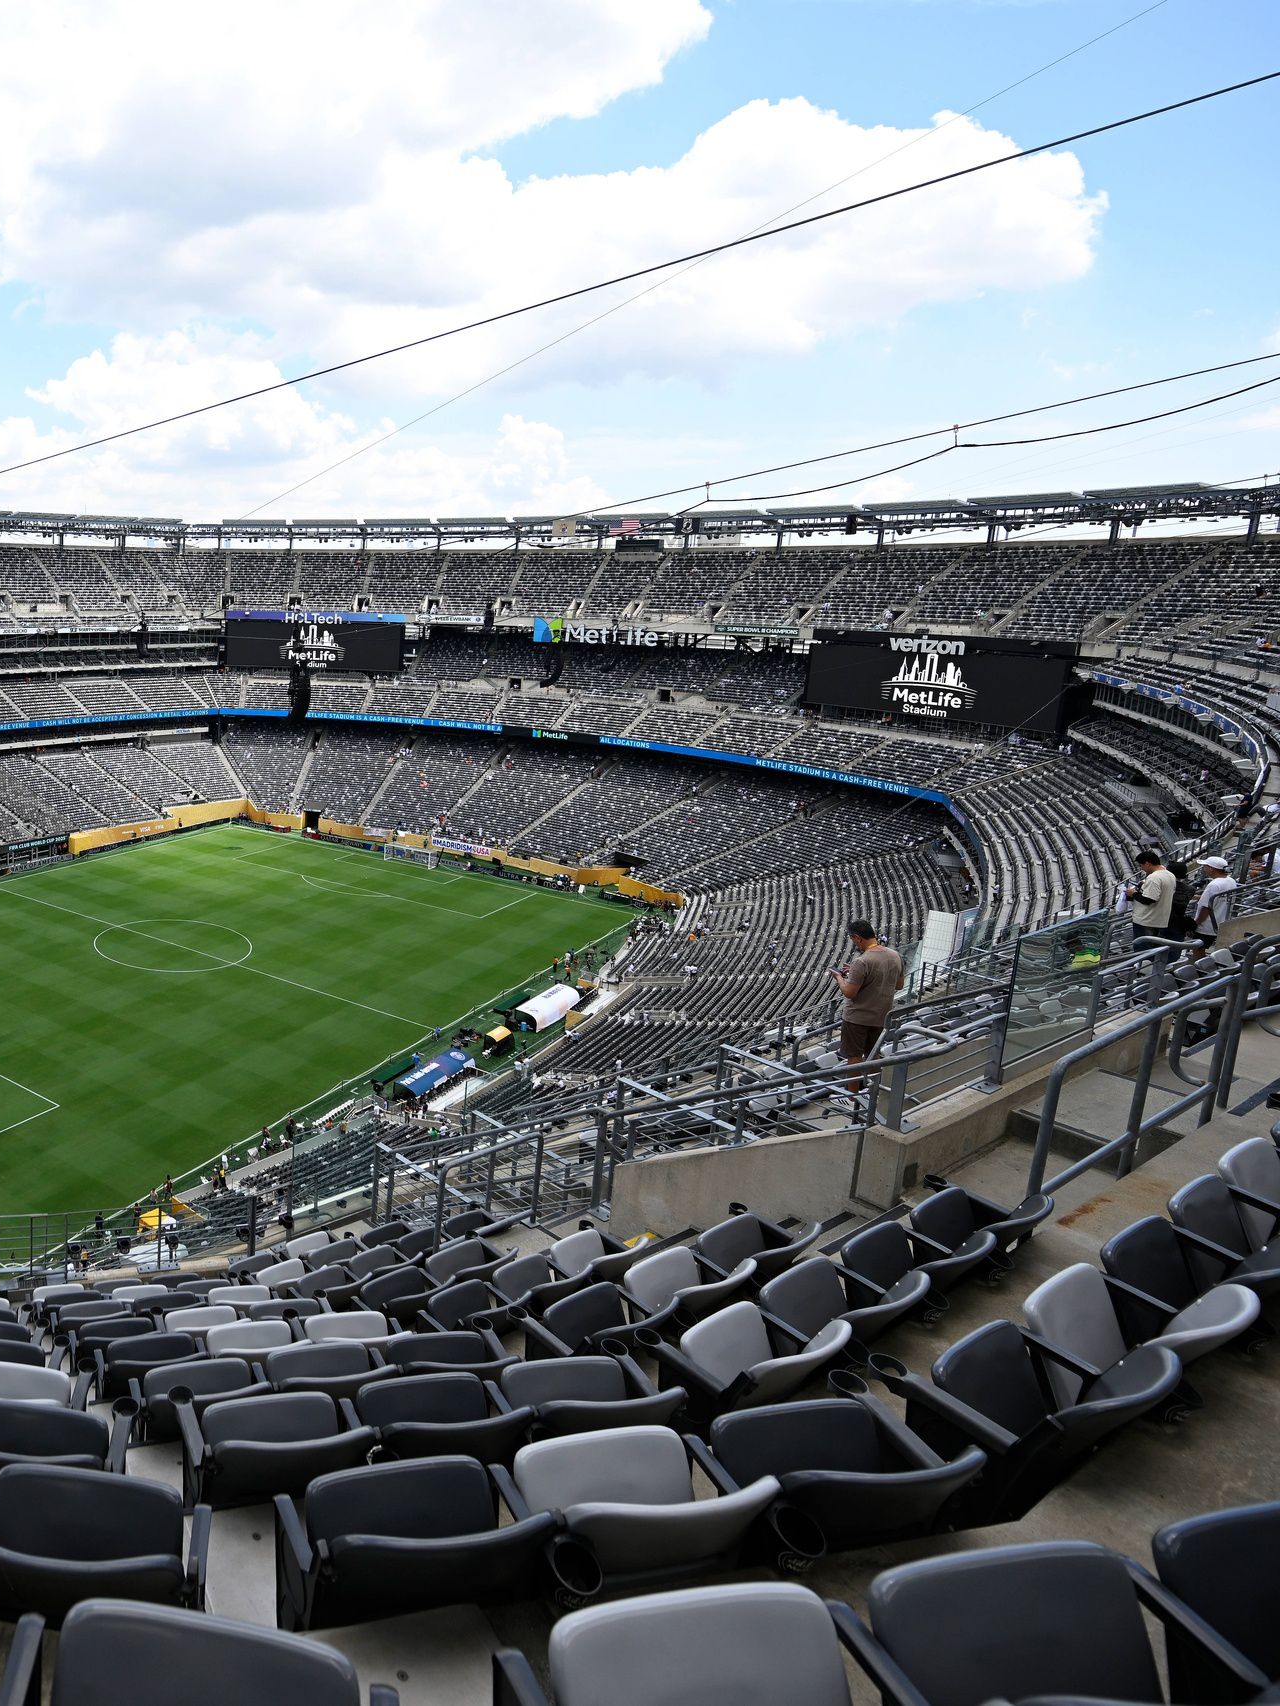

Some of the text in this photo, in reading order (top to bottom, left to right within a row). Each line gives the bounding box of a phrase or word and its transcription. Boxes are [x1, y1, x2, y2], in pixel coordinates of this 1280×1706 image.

[285, 613, 342, 624] HCLTech
[565, 624, 659, 647] MetLife
[889, 635, 965, 655] verizon
[892, 687, 962, 709] MetLife
[902, 703, 947, 717] Stadium
[91, 715, 119, 723] ACCEPTED
[127, 712, 158, 720] CONCESSION
[369, 715, 403, 723] CASH-FREE
[404, 717, 424, 725] VENUE
[542, 731, 568, 740] MetLife
[613, 738, 650, 748] LOCATIONS
[756, 759, 787, 771] METLIFE
[789, 764, 821, 777] STADIUM
[822, 770, 830, 779] IS
[839, 774, 882, 788] CASH-FREE
[884, 782, 909, 794] VENUE
[30, 839, 45, 847] WORLD
[499, 870, 520, 881] ULTRA
